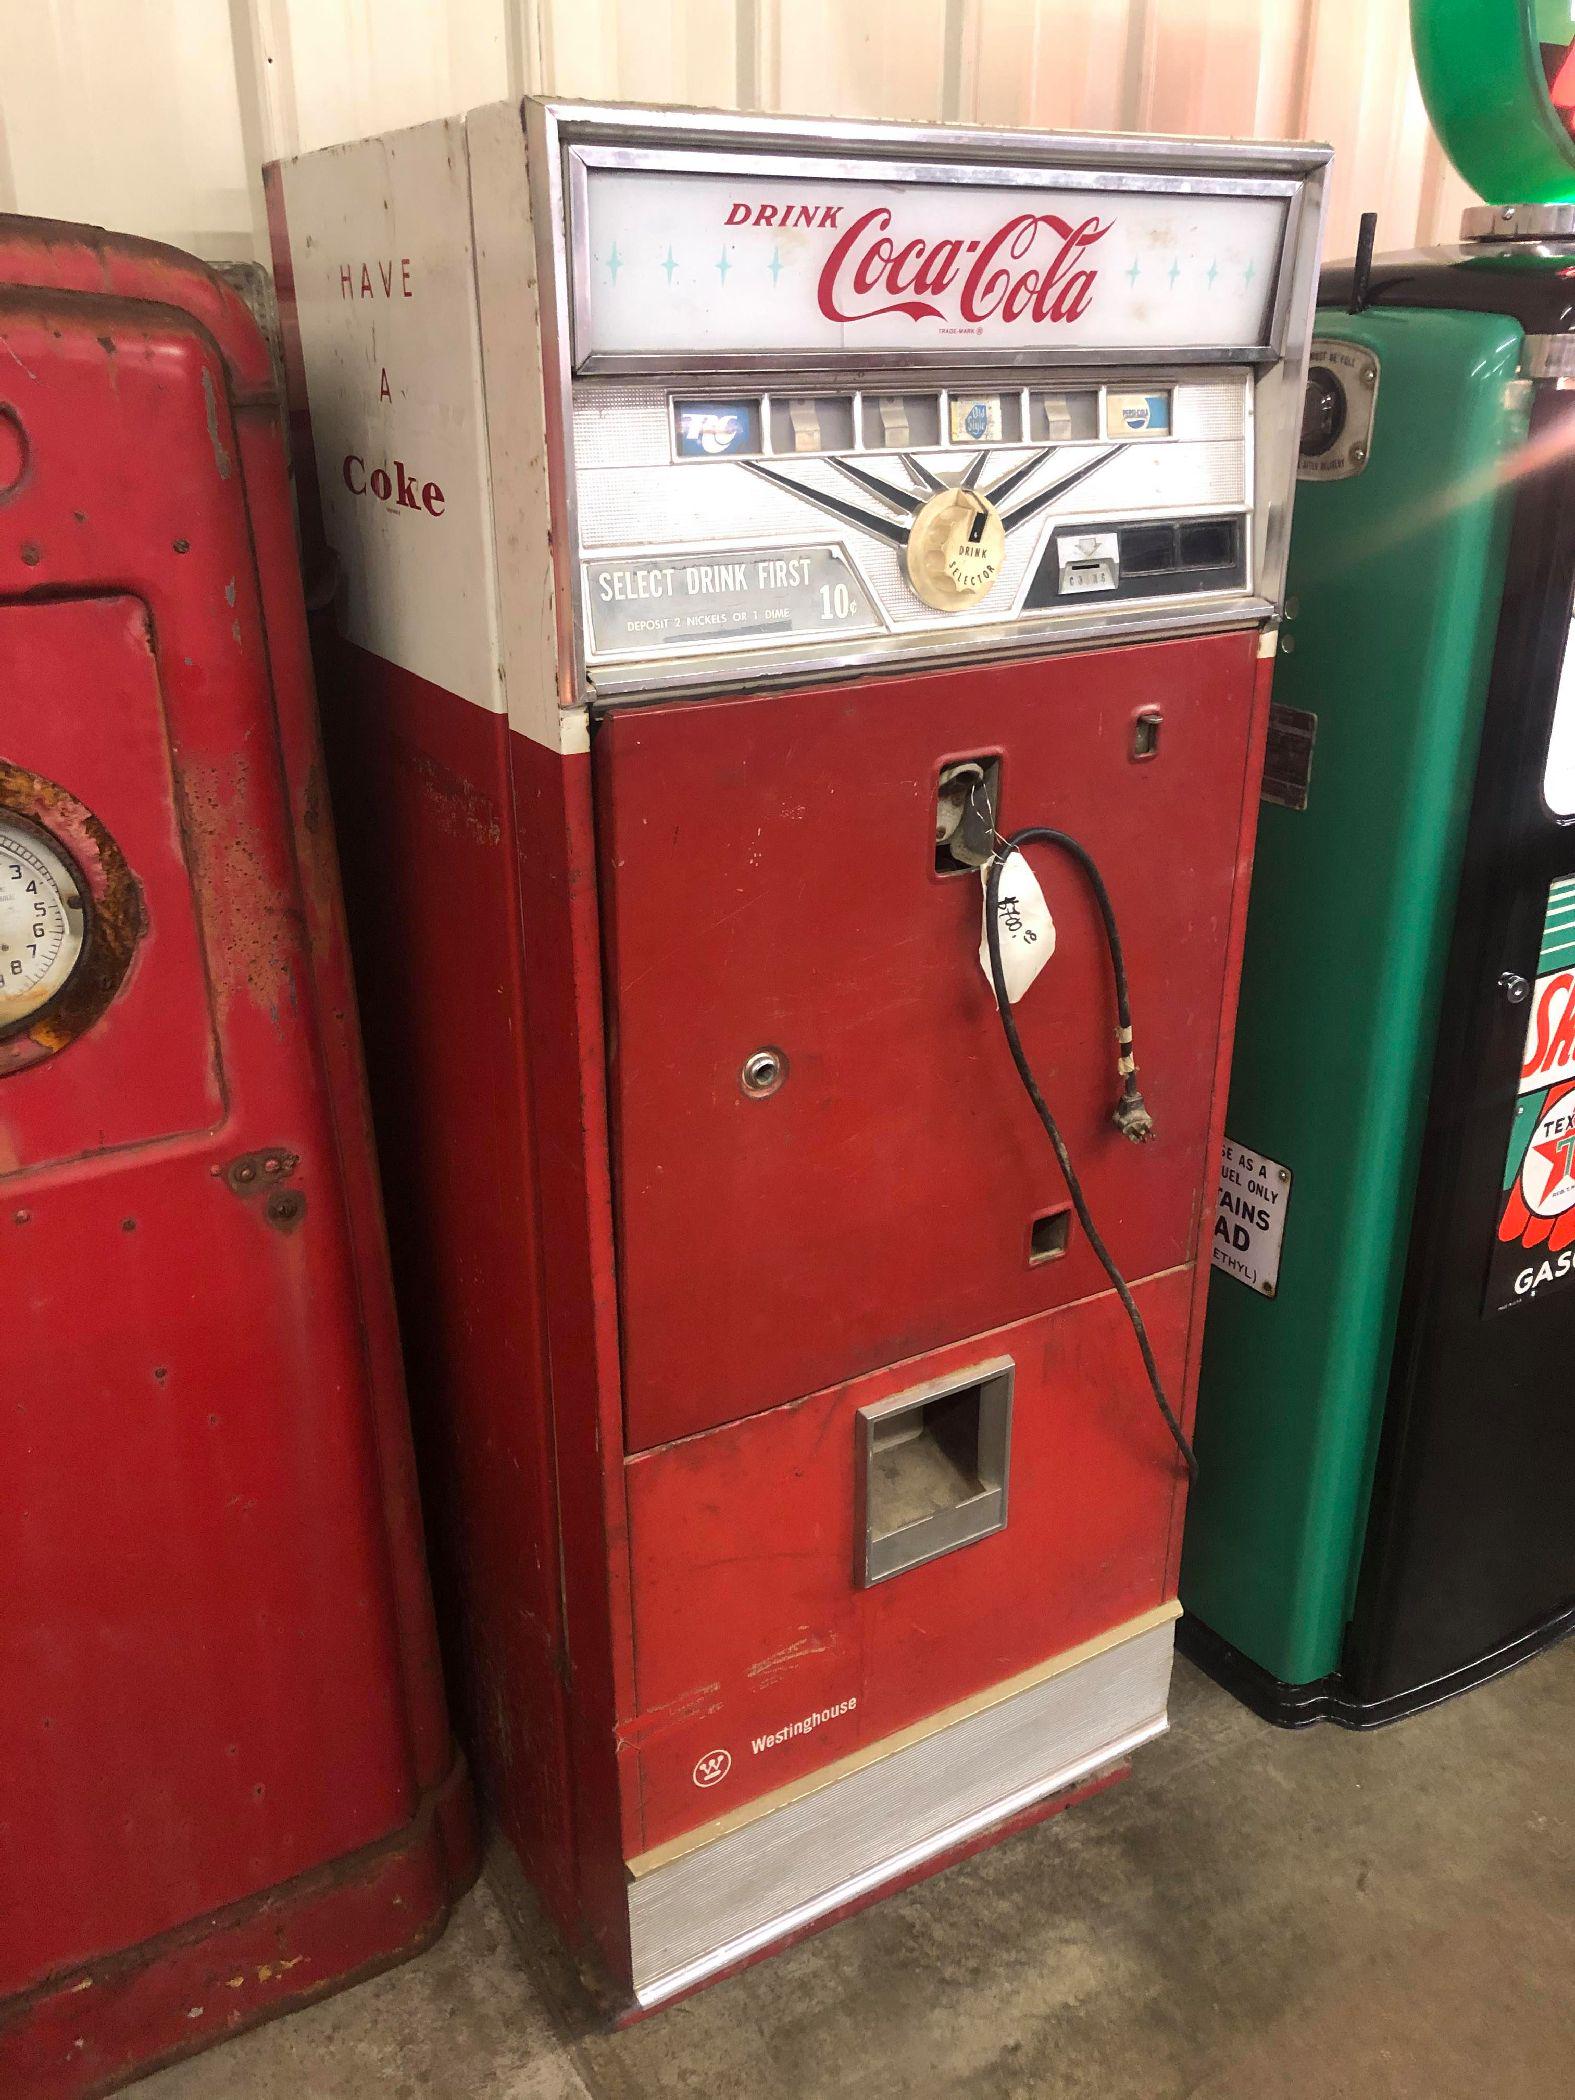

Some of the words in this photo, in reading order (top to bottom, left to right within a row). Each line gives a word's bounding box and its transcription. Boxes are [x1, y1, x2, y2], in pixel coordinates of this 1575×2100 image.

[724, 203, 844, 229] DRINK
[817, 207, 1118, 324] Coca-Cola
[340, 259, 412, 299] HAVE
[380, 367, 392, 403] A
[343, 454, 445, 517] Coke
[959, 545, 988, 558] DRINK
[599, 568, 675, 602] SELECT
[686, 563, 748, 595] DRINK
[758, 559, 811, 589] FIRST
[949, 561, 995, 586] SELECTOR
[819, 583, 858, 620] 10¢
[627, 619, 670, 632] DEPOSIT
[674, 617, 681, 628] 2
[687, 613, 727, 627] NICKELS
[733, 612, 747, 622] OR
[753, 610, 758, 620] 1
[765, 607, 790, 619] DIME
[9, 864, 22, 880] 3
[26, 880, 37, 895] 4
[34, 902, 47, 918] 5
[32, 922, 45, 938] 6
[26, 944, 37, 958] 7
[10, 960, 23, 976] 8
[1239, 1154, 1254, 1172] AS
[1259, 1165, 1267, 1179] A
[1248, 1180, 1278, 1205] ONLY
[1218, 1187, 1270, 1231] AINS
[1214, 1215, 1250, 1252] AD
[1213, 1247, 1257, 1284] ETHYL)
[1514, 1250, 1575, 1295] GAS
[751, 1697, 857, 1755] Westinghouse
